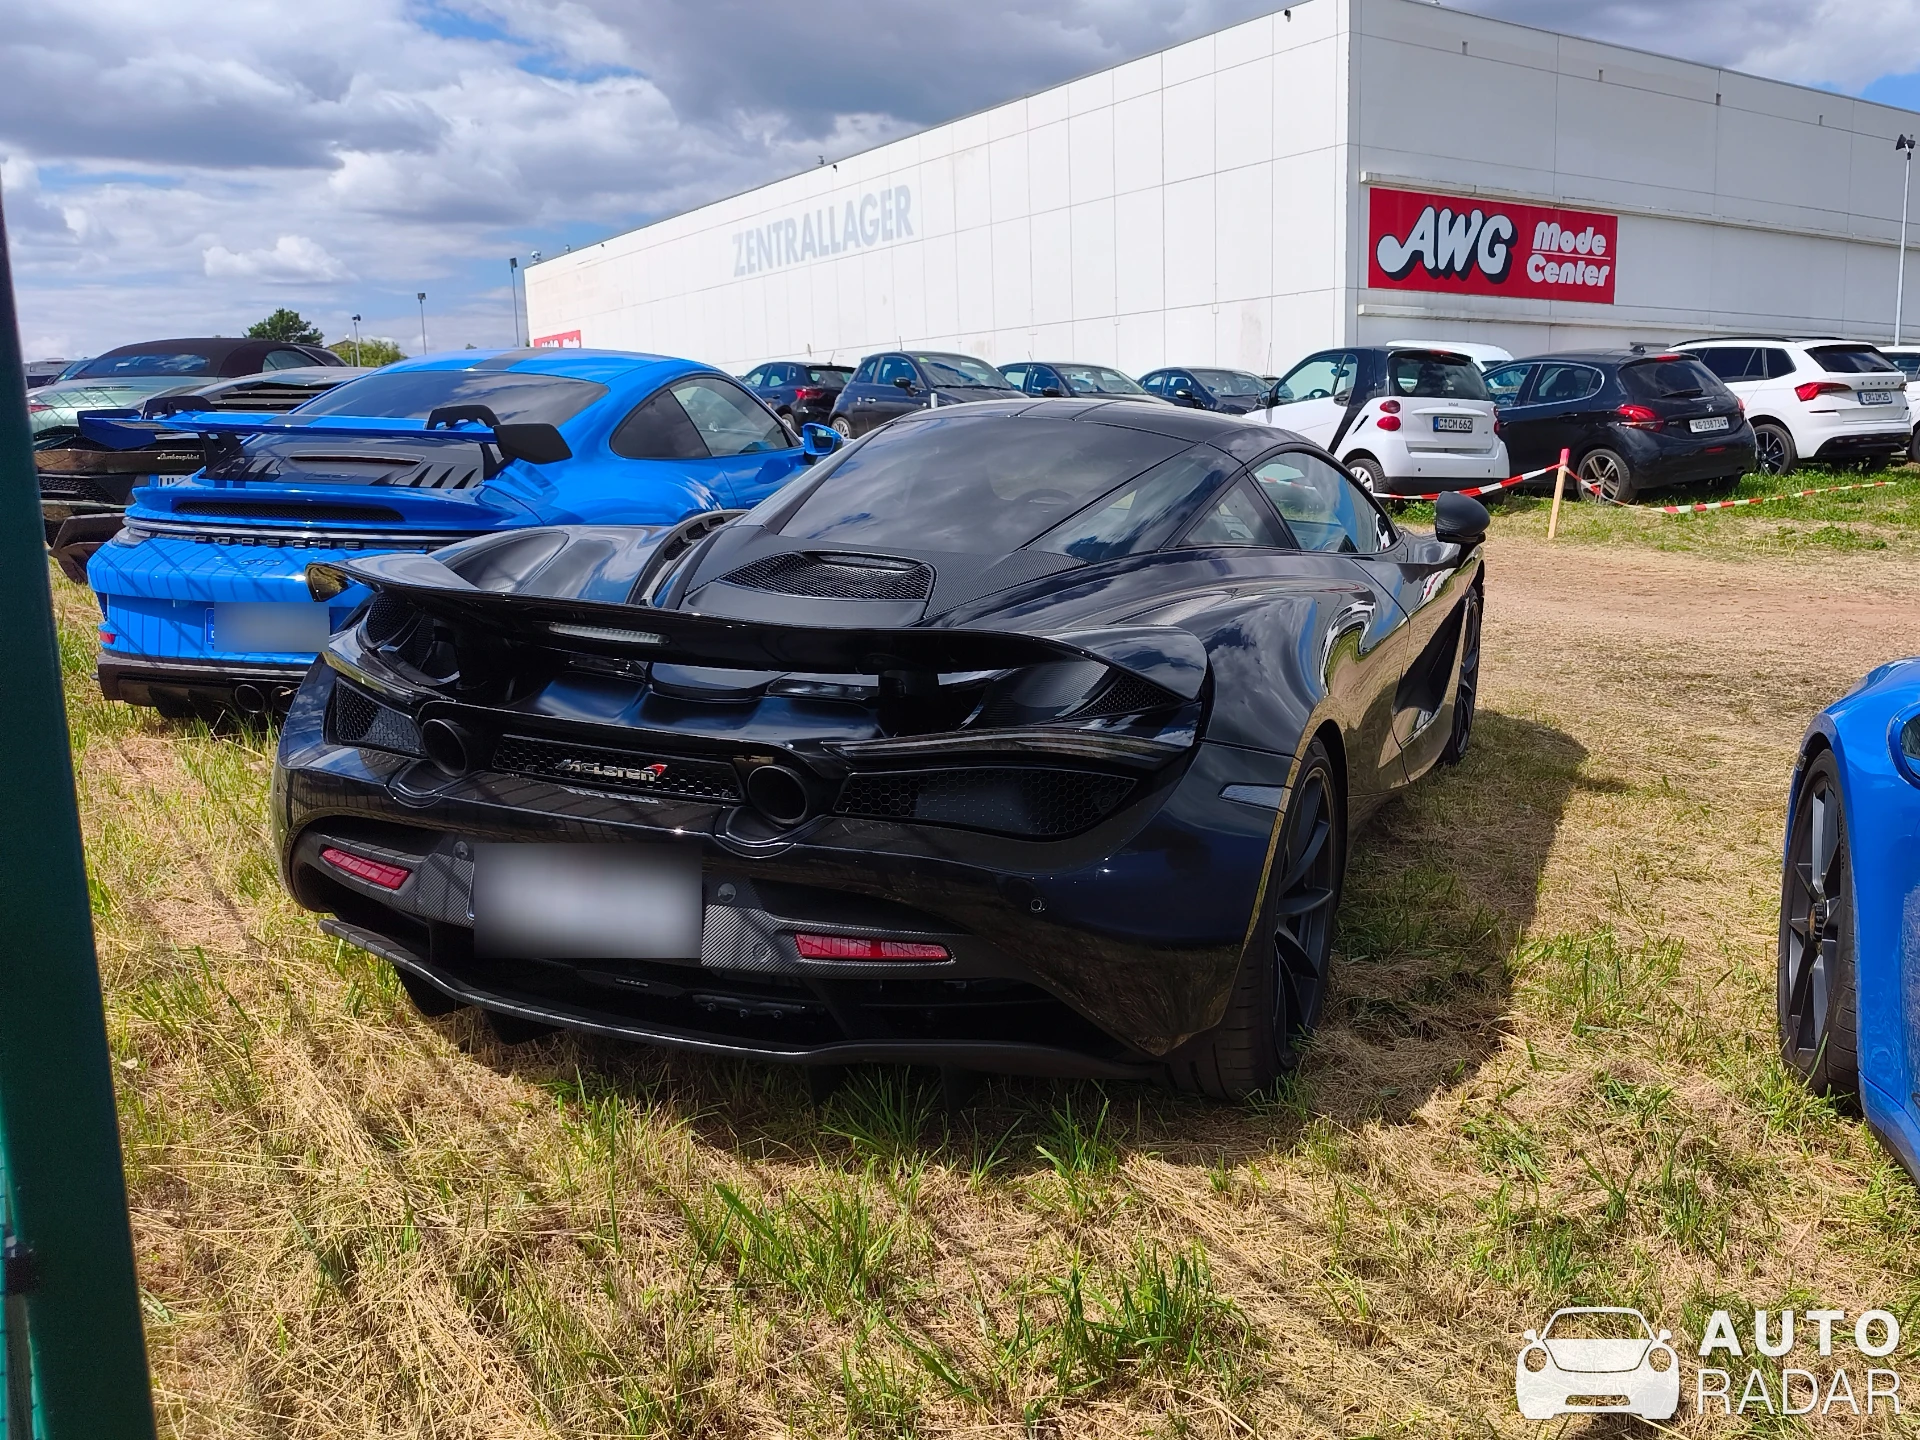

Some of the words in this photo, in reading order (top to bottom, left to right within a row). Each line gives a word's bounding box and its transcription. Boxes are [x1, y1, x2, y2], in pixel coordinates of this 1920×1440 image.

[732, 185, 914, 277] ZENTRALLAGER
[1377, 206, 1515, 278] AWG
[1533, 222, 1606, 255] Mode
[1527, 254, 1610, 287] Center
[1459, 420, 1472, 430] 662
[555, 759, 657, 781] McLaren
